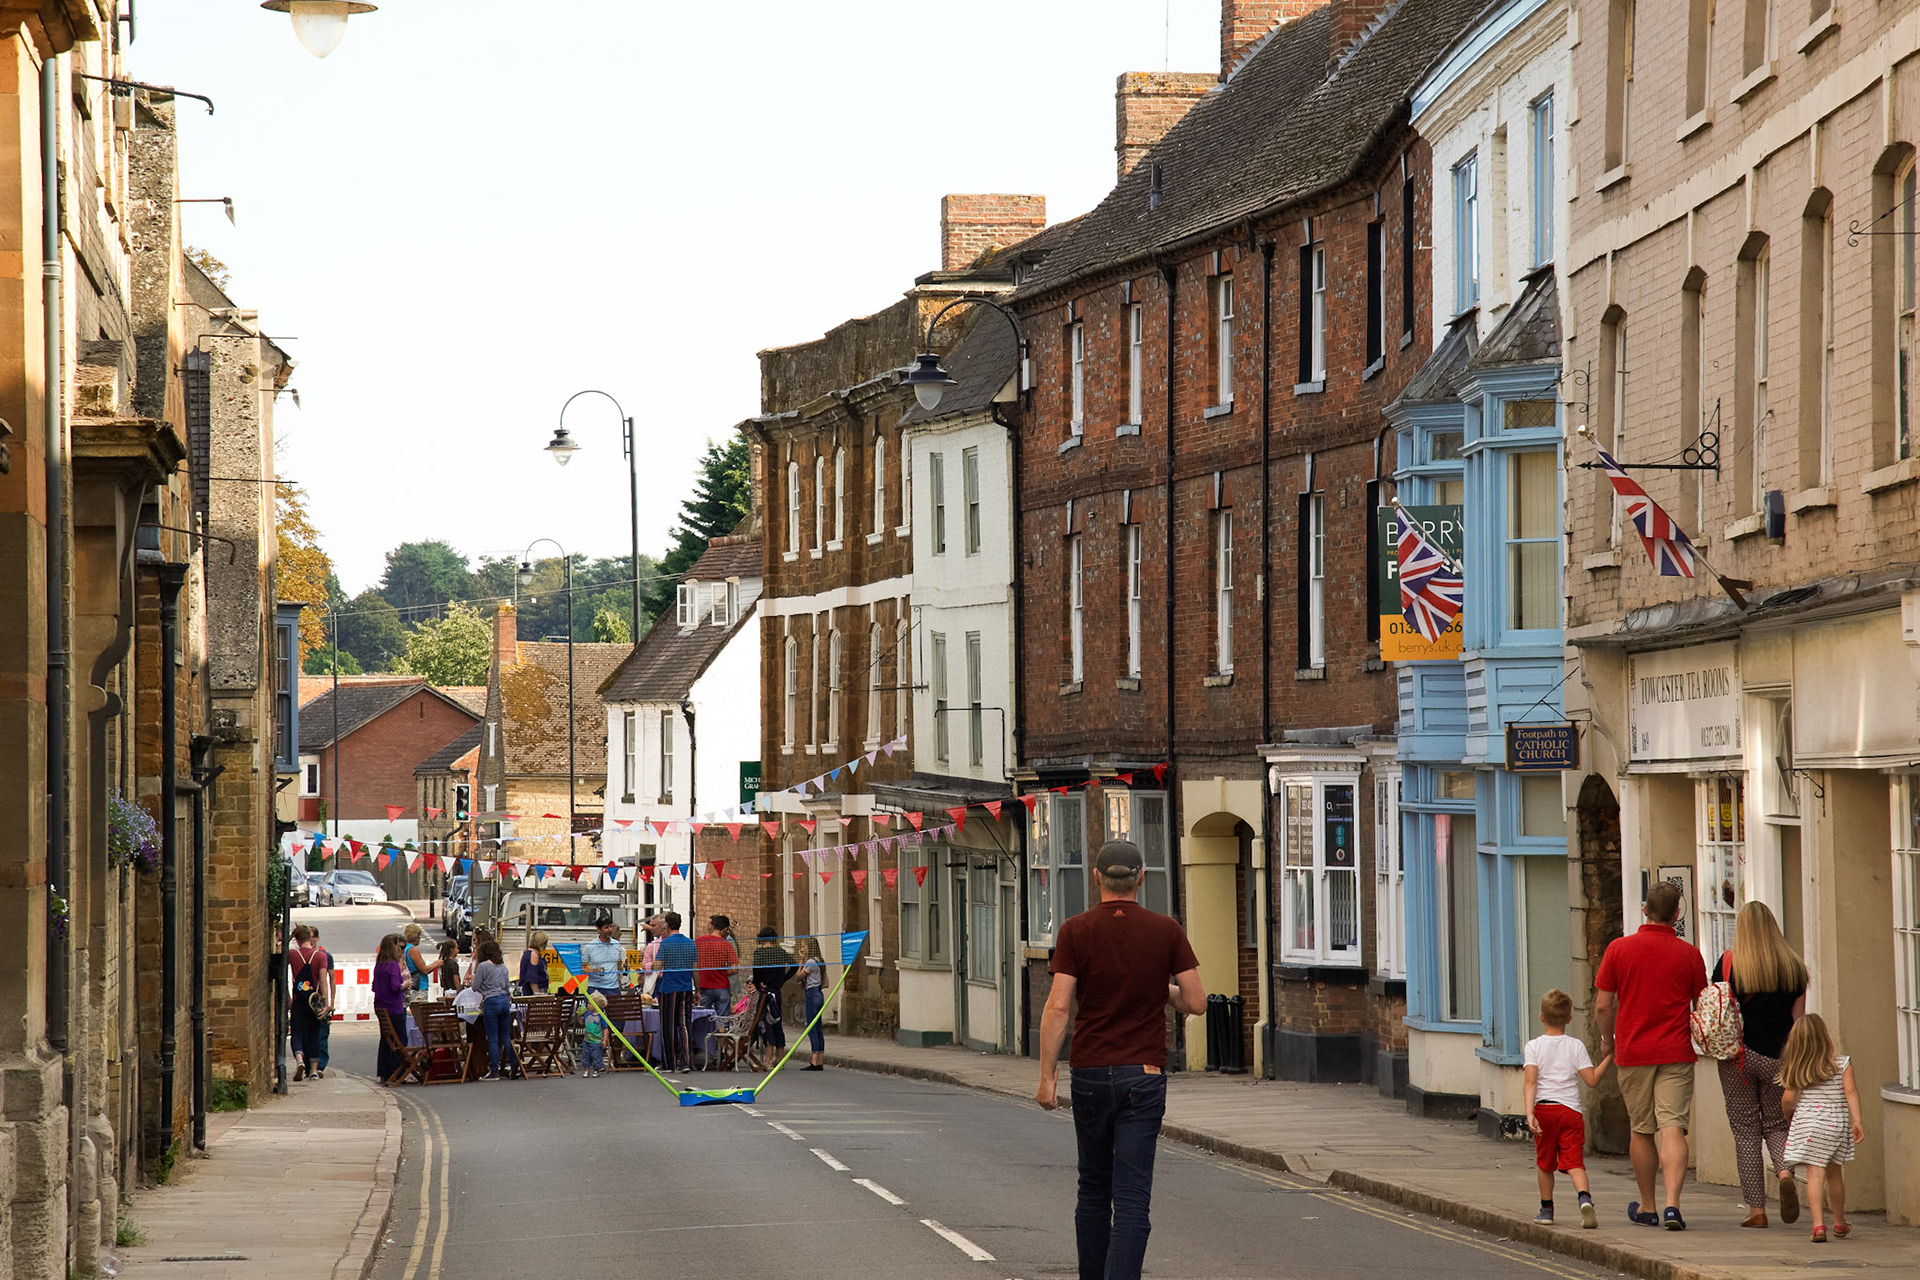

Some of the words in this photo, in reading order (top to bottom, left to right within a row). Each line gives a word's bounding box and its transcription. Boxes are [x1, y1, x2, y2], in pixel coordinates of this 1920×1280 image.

[1640, 673, 1685, 705] TOWCESTER
[1686, 671, 1702, 700] TEA
[1702, 666, 1730, 699] ROOMS
[1517, 729, 1557, 740] Footpath
[1558, 730, 1568, 738] to
[1515, 739, 1570, 750] CATHOLIC
[1519, 749, 1566, 759] CHURCH
